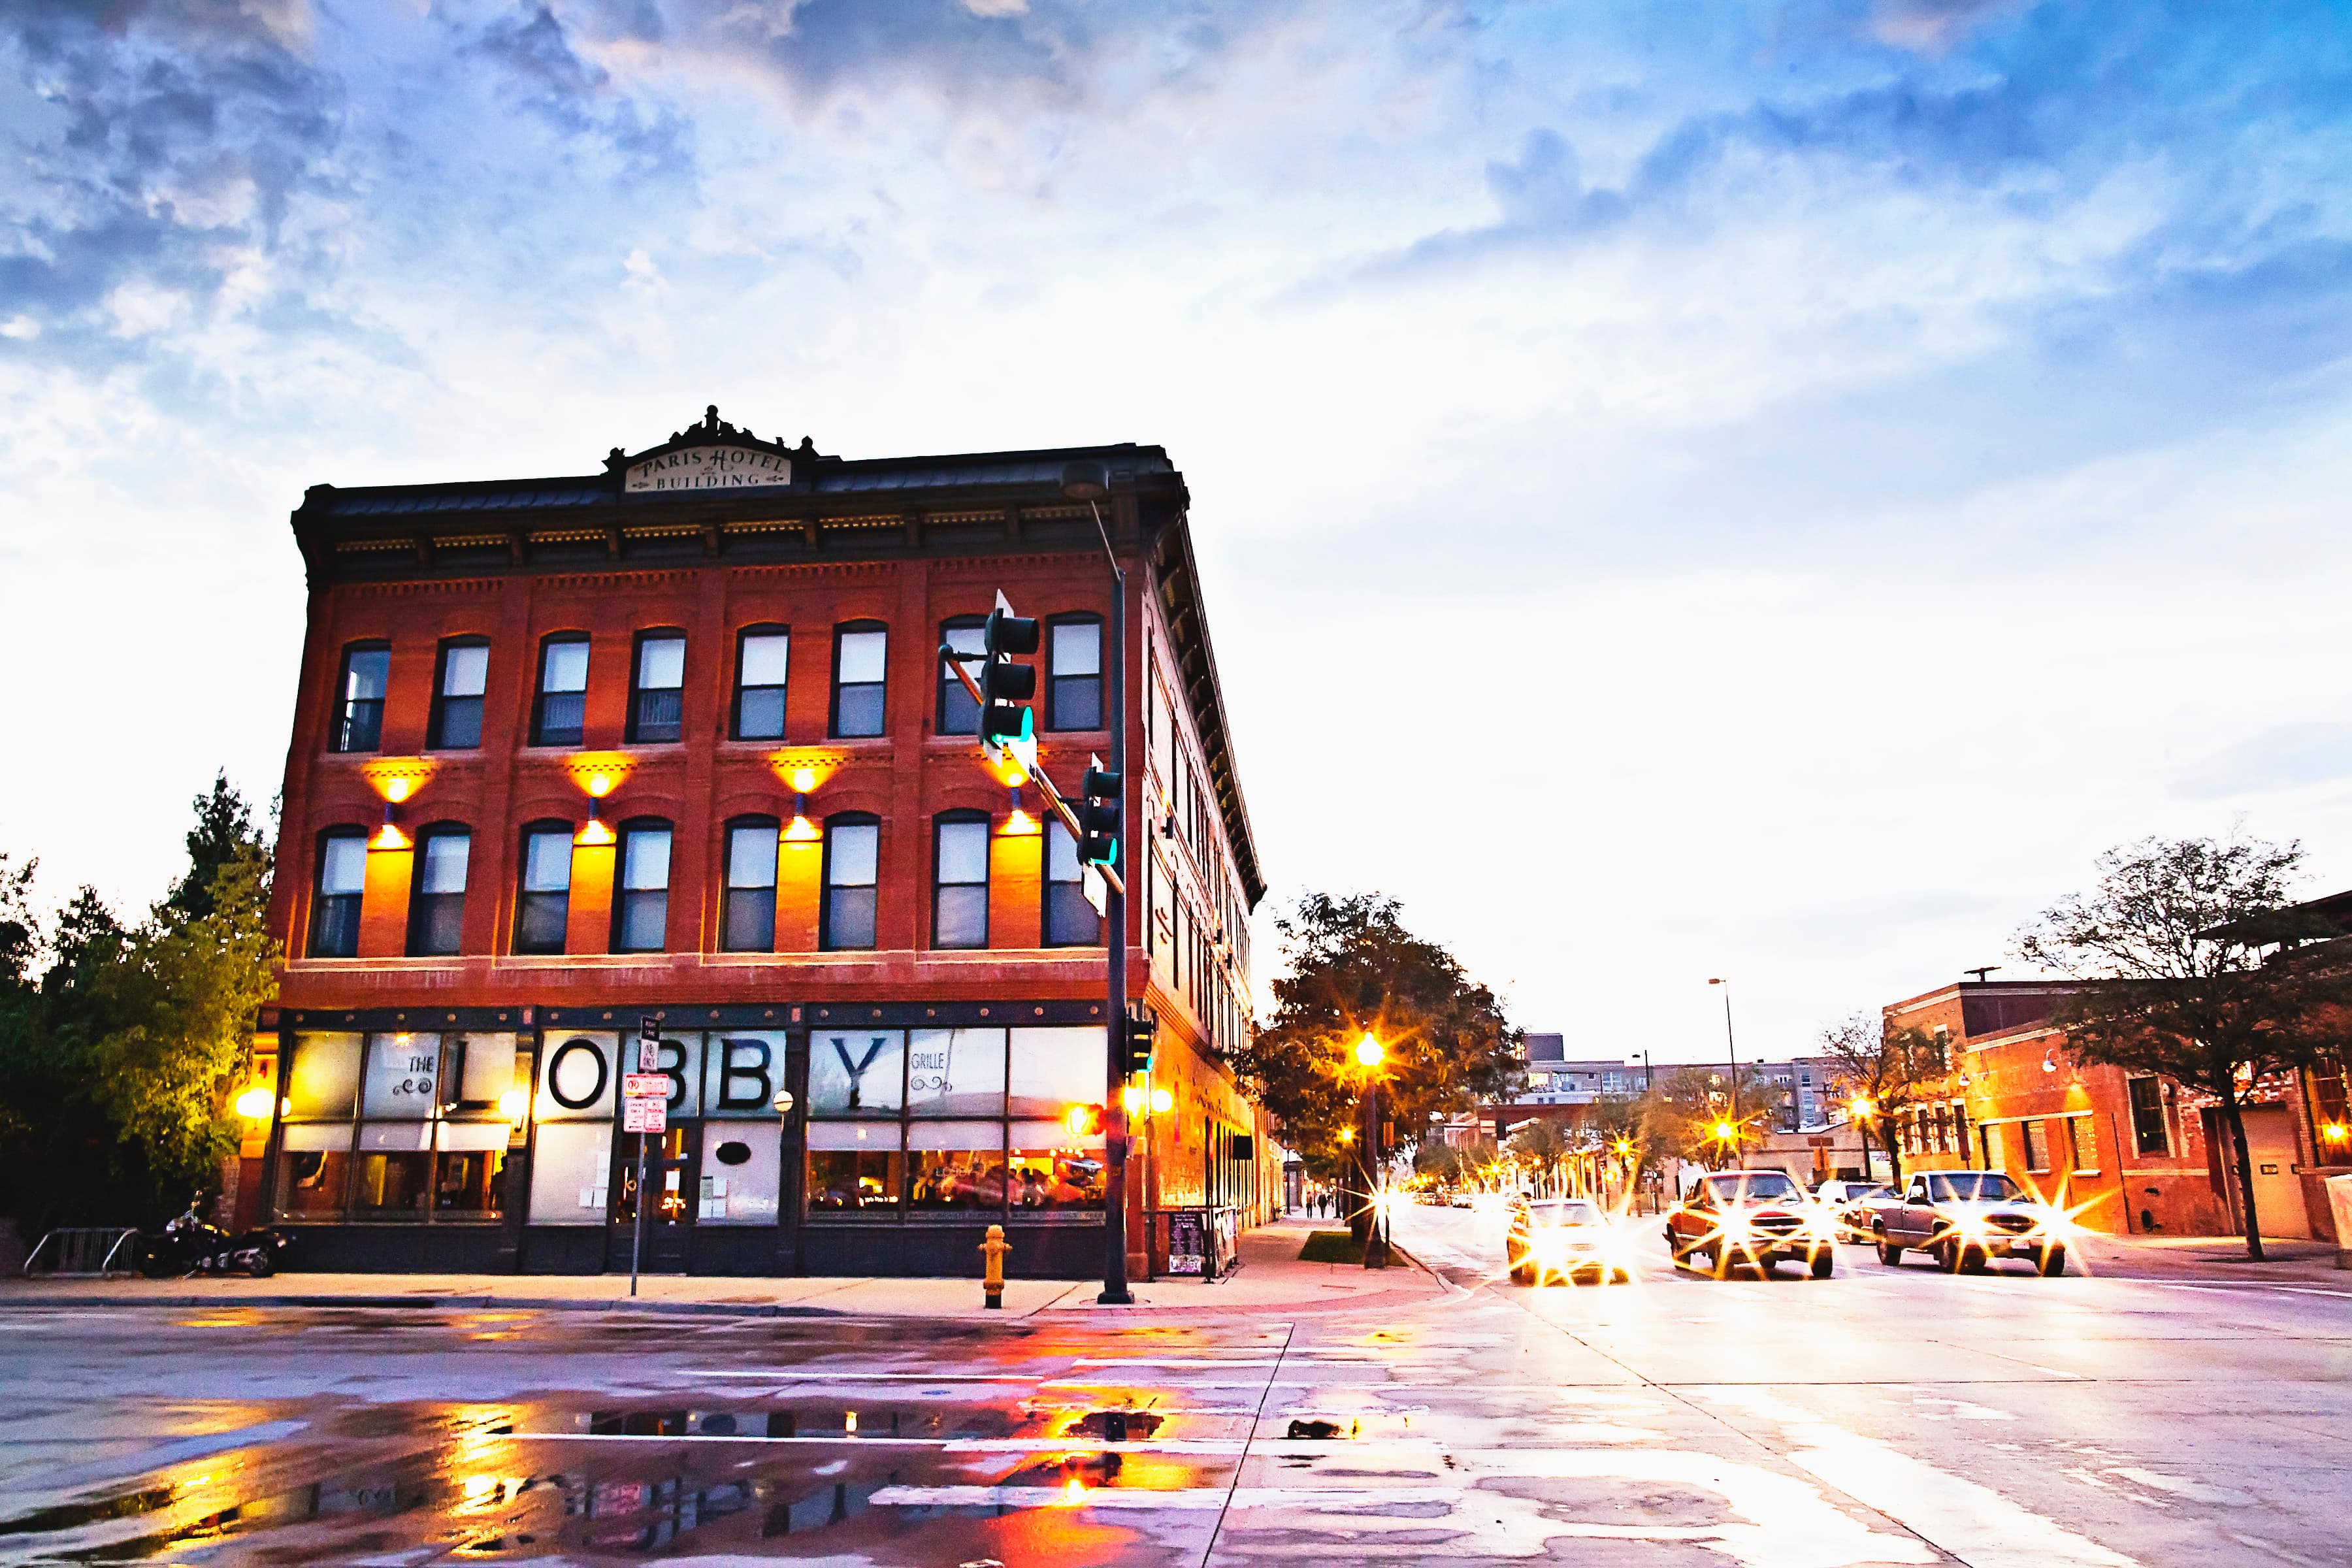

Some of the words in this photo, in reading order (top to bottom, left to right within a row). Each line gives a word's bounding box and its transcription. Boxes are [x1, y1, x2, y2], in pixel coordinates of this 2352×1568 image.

[642, 451, 702, 478] PARIS
[710, 449, 783, 472] HOTEL
[657, 474, 759, 489] BUILDING
[409, 1056, 434, 1073] THE
[911, 1053, 945, 1070] GRILLE
